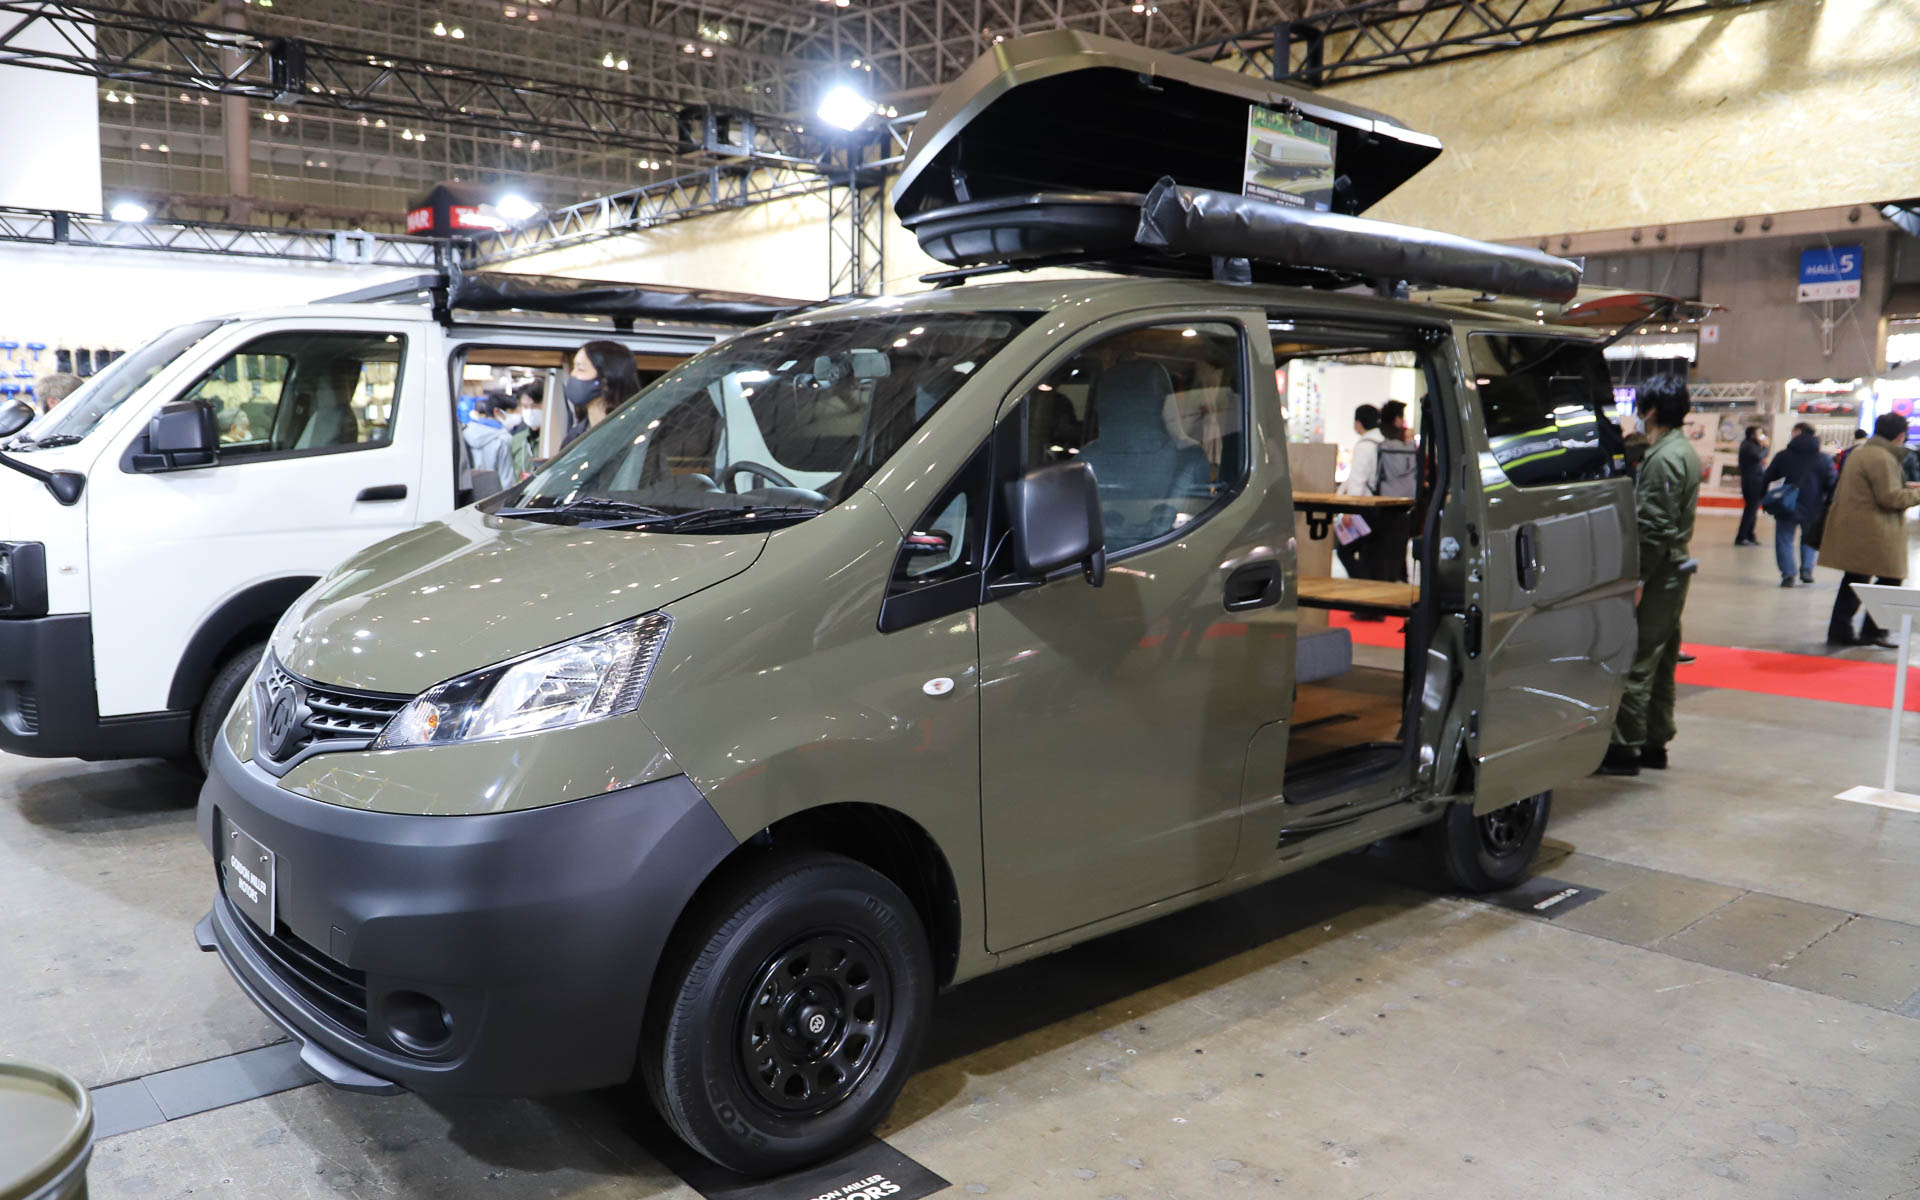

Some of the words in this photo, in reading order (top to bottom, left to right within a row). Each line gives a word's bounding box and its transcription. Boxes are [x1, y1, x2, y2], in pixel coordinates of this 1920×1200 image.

[1805, 263, 1836, 276] HALL
[1839, 254, 1854, 274] 5
[230, 855, 250, 882] GORDON
[250, 872, 267, 896] MILLER
[238, 876, 258, 904] MOTORS
[841, 1174, 886, 1194] MILLER
